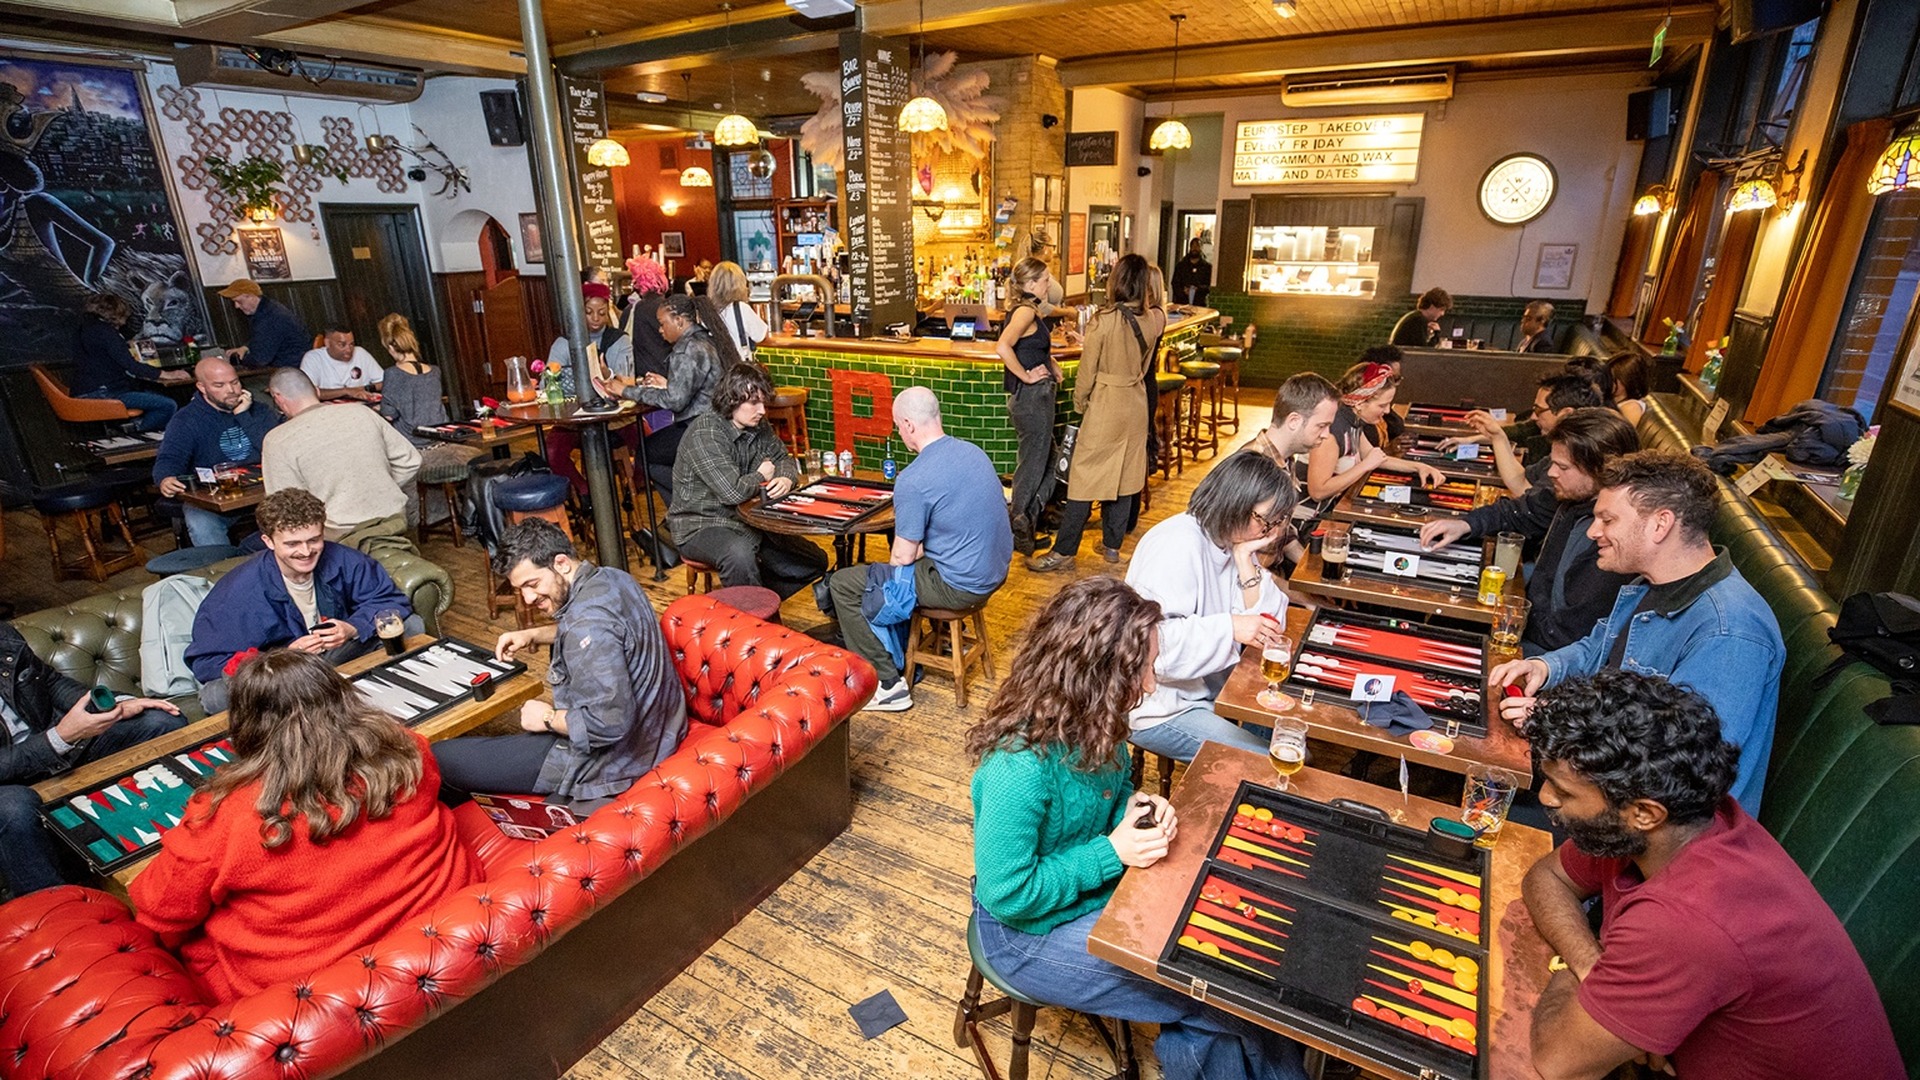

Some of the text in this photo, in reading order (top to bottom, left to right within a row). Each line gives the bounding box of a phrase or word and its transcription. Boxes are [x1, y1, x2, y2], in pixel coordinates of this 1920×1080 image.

[843, 58, 858, 76] BAR
[1244, 124, 1308, 137] EUROSTEP
[847, 136, 861, 147] NUTS
[1236, 151, 1393, 167] BACKGAMMON AND WAX
[848, 169, 863, 182] PORK
[1235, 169, 1358, 181] MAT AND DATES
[849, 213, 866, 228] LUNCH
[851, 224, 865, 236] TIME
[851, 234, 865, 246] DEAL
